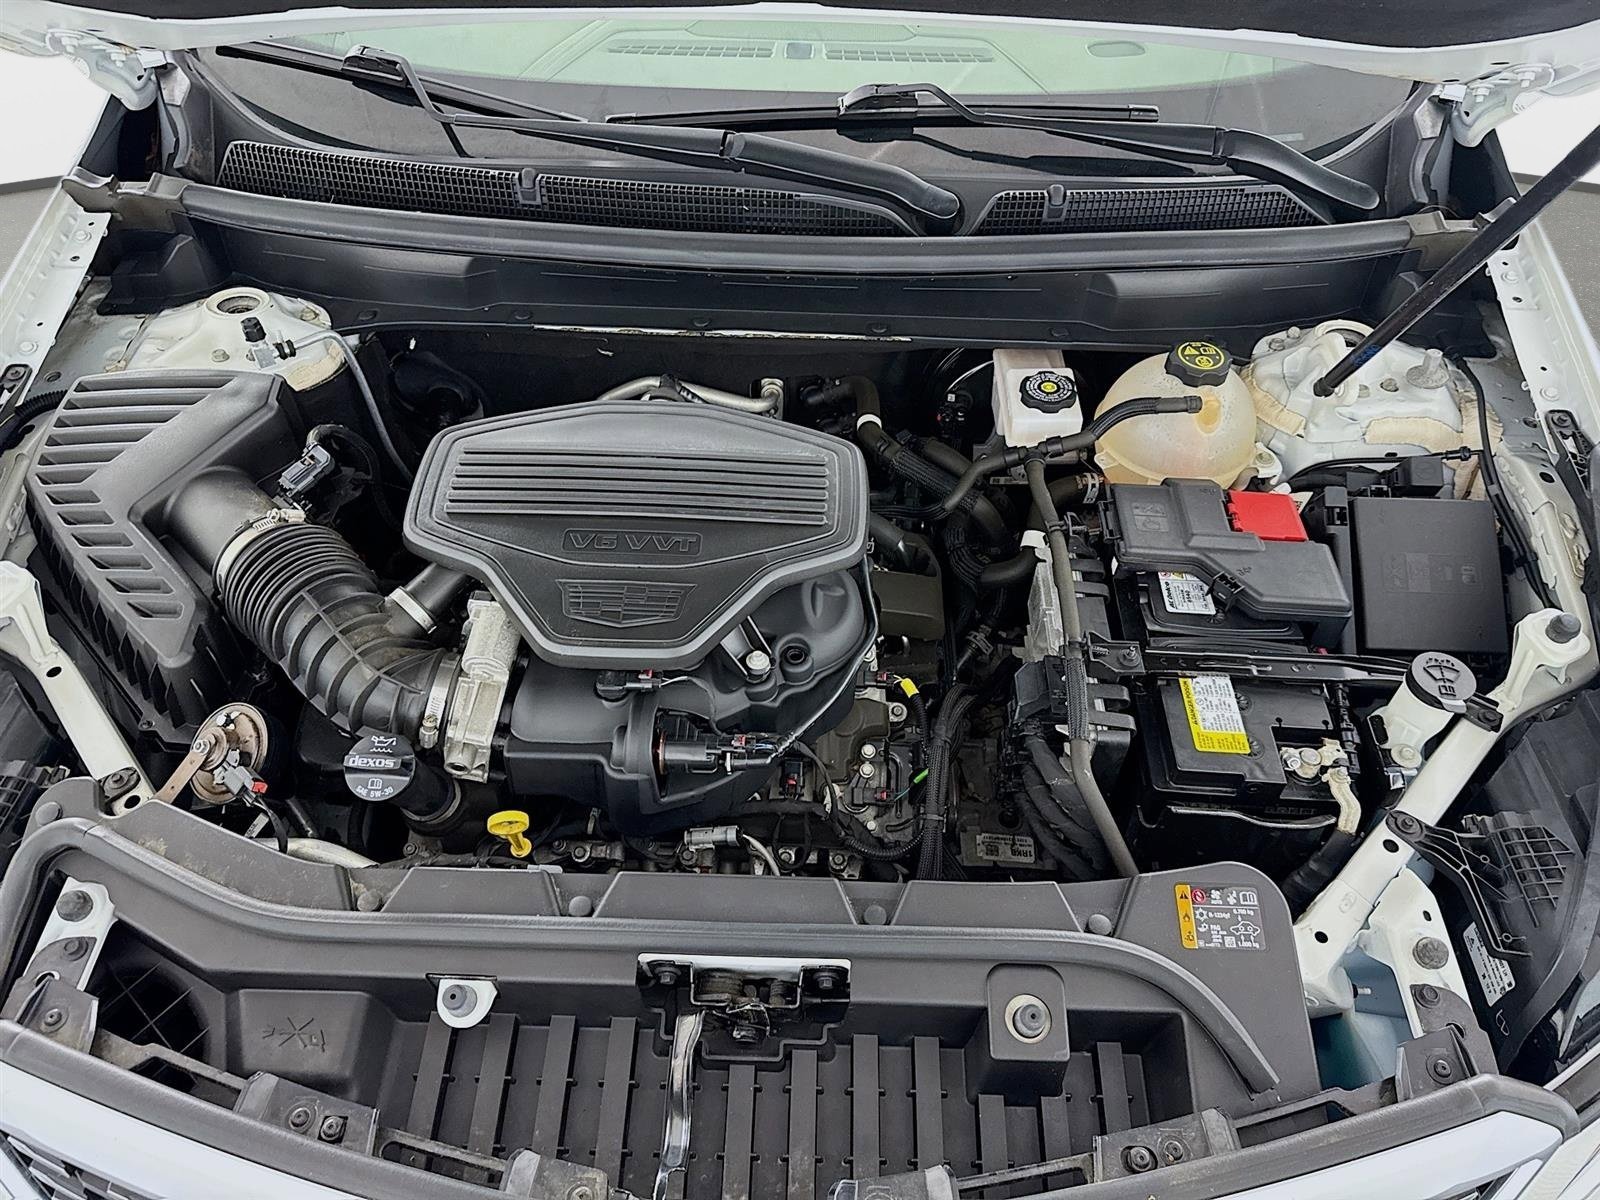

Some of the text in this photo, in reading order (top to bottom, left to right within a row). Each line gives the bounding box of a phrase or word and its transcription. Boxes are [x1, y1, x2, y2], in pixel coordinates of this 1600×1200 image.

[569, 533, 697, 552] V6 VVT
[349, 755, 395, 768] dexos
[356, 785, 394, 798] SAE 5W-30
